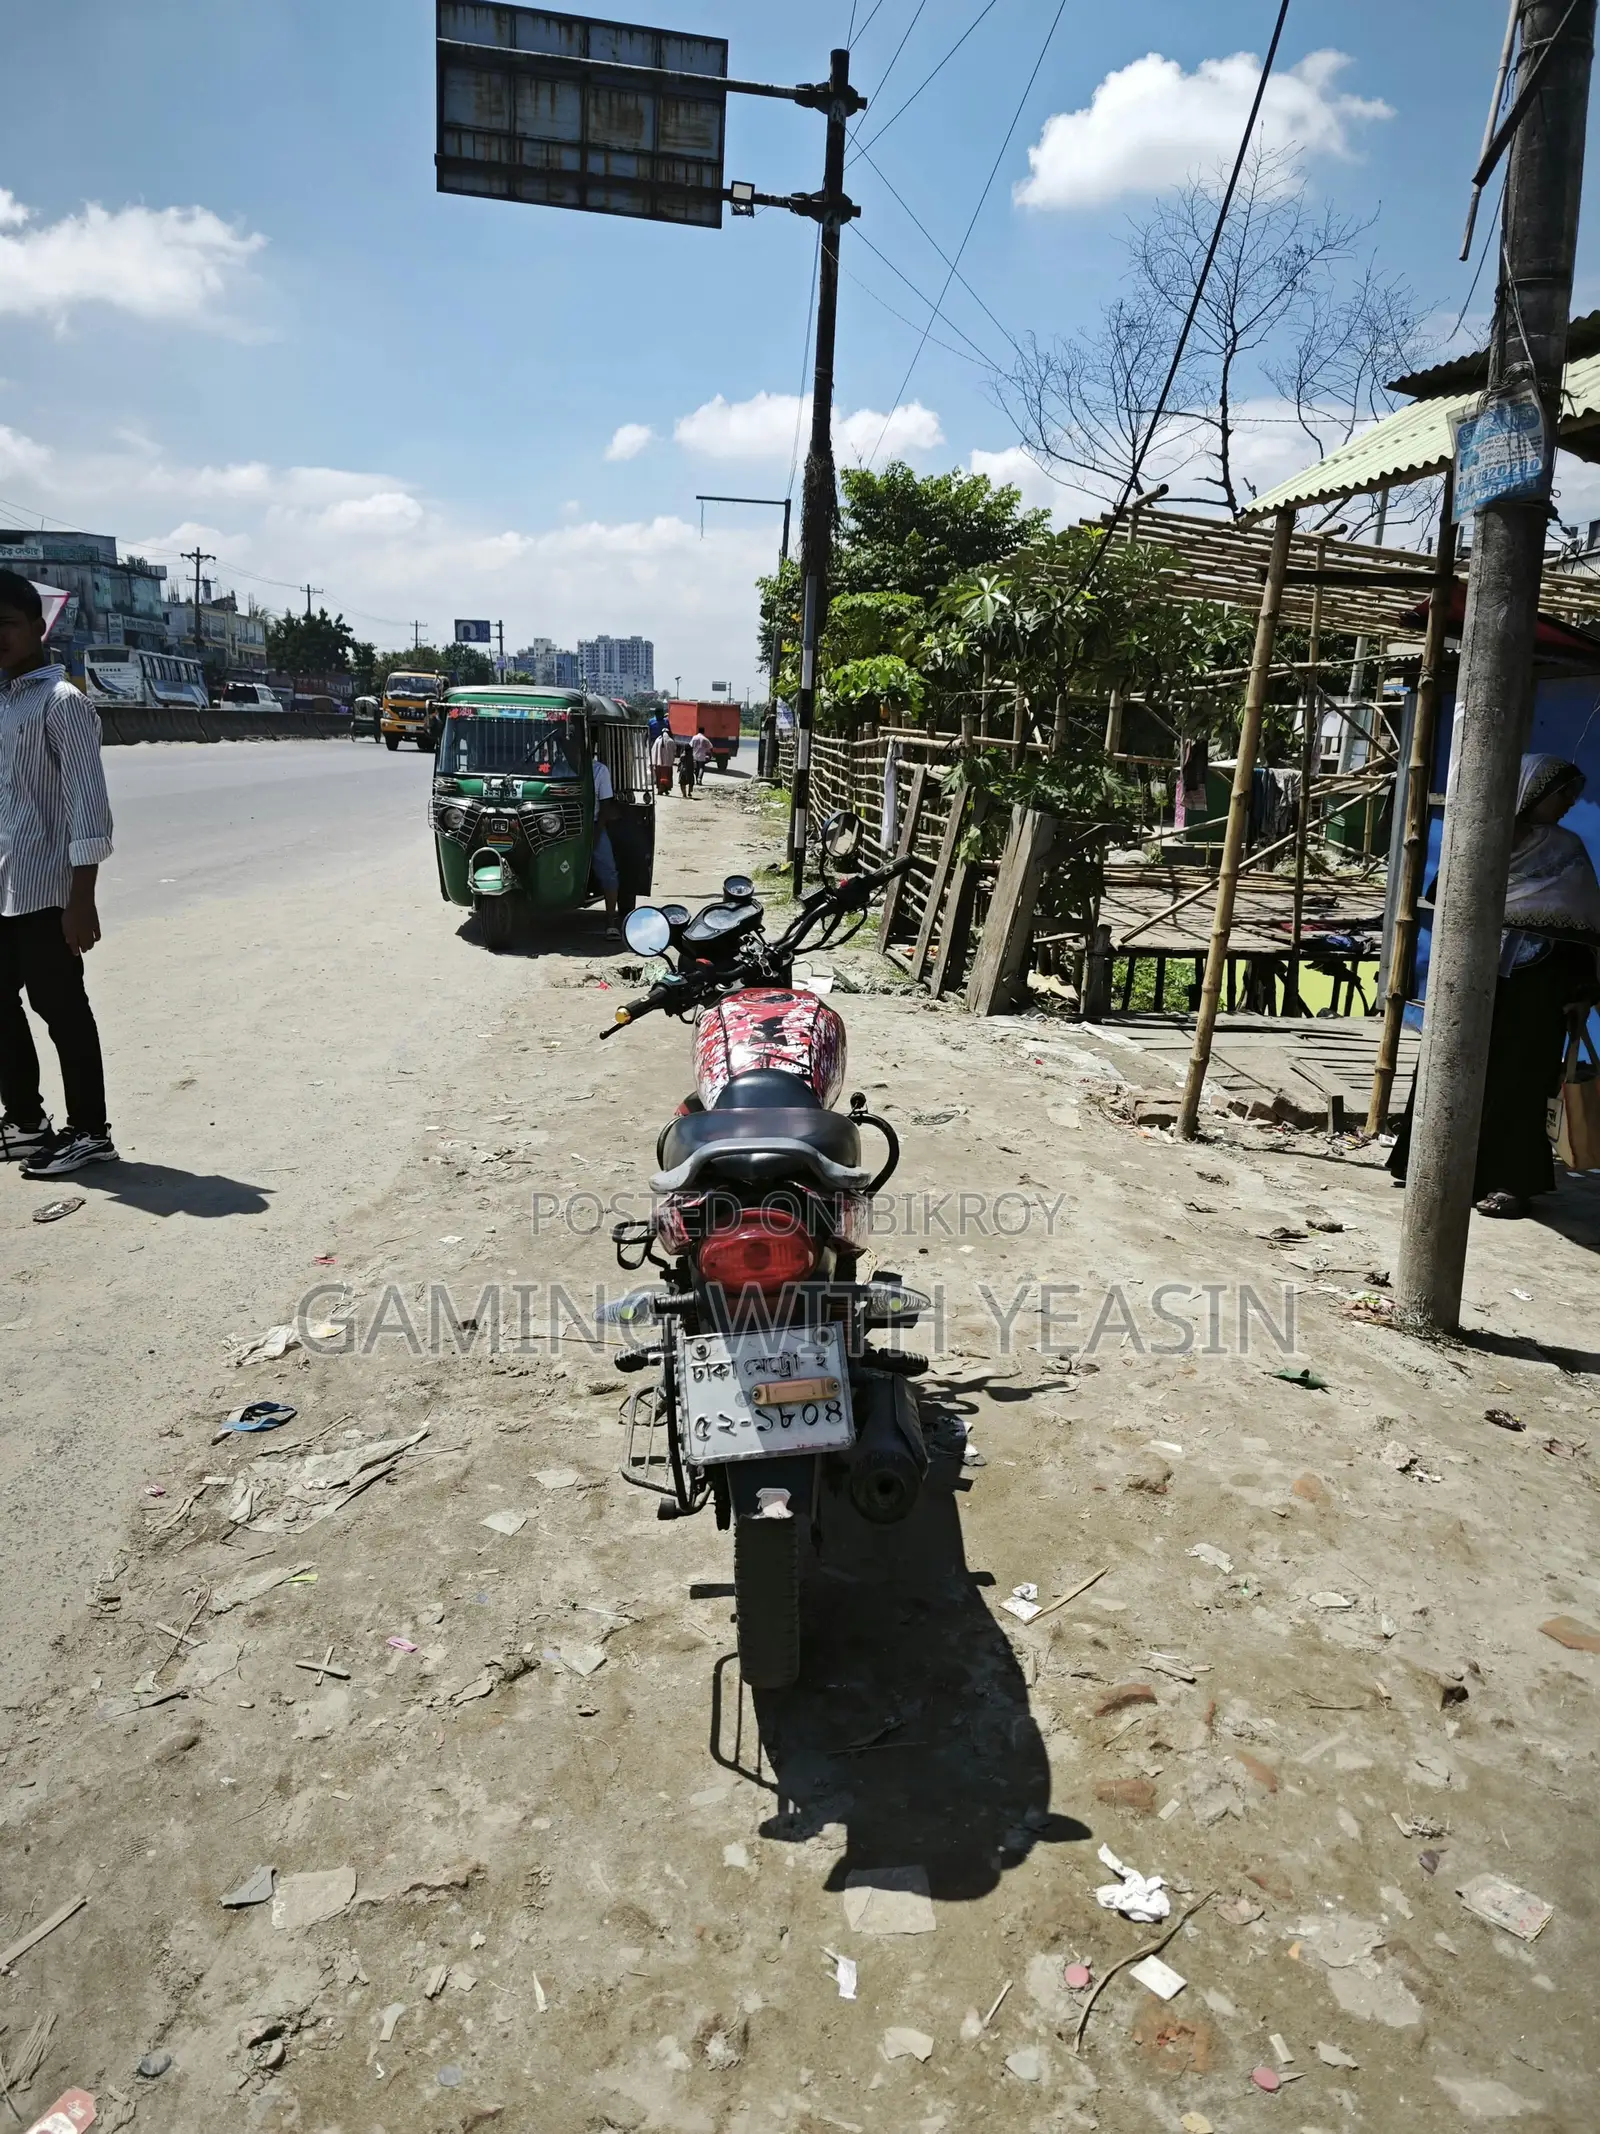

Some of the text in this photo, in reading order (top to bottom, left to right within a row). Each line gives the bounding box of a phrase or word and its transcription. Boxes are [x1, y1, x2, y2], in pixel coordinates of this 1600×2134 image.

[494, 822, 506, 831] RE
[690, 1361, 737, 1382] ঢাকা
[693, 1400, 843, 1442] ৫২-১৮০৪
